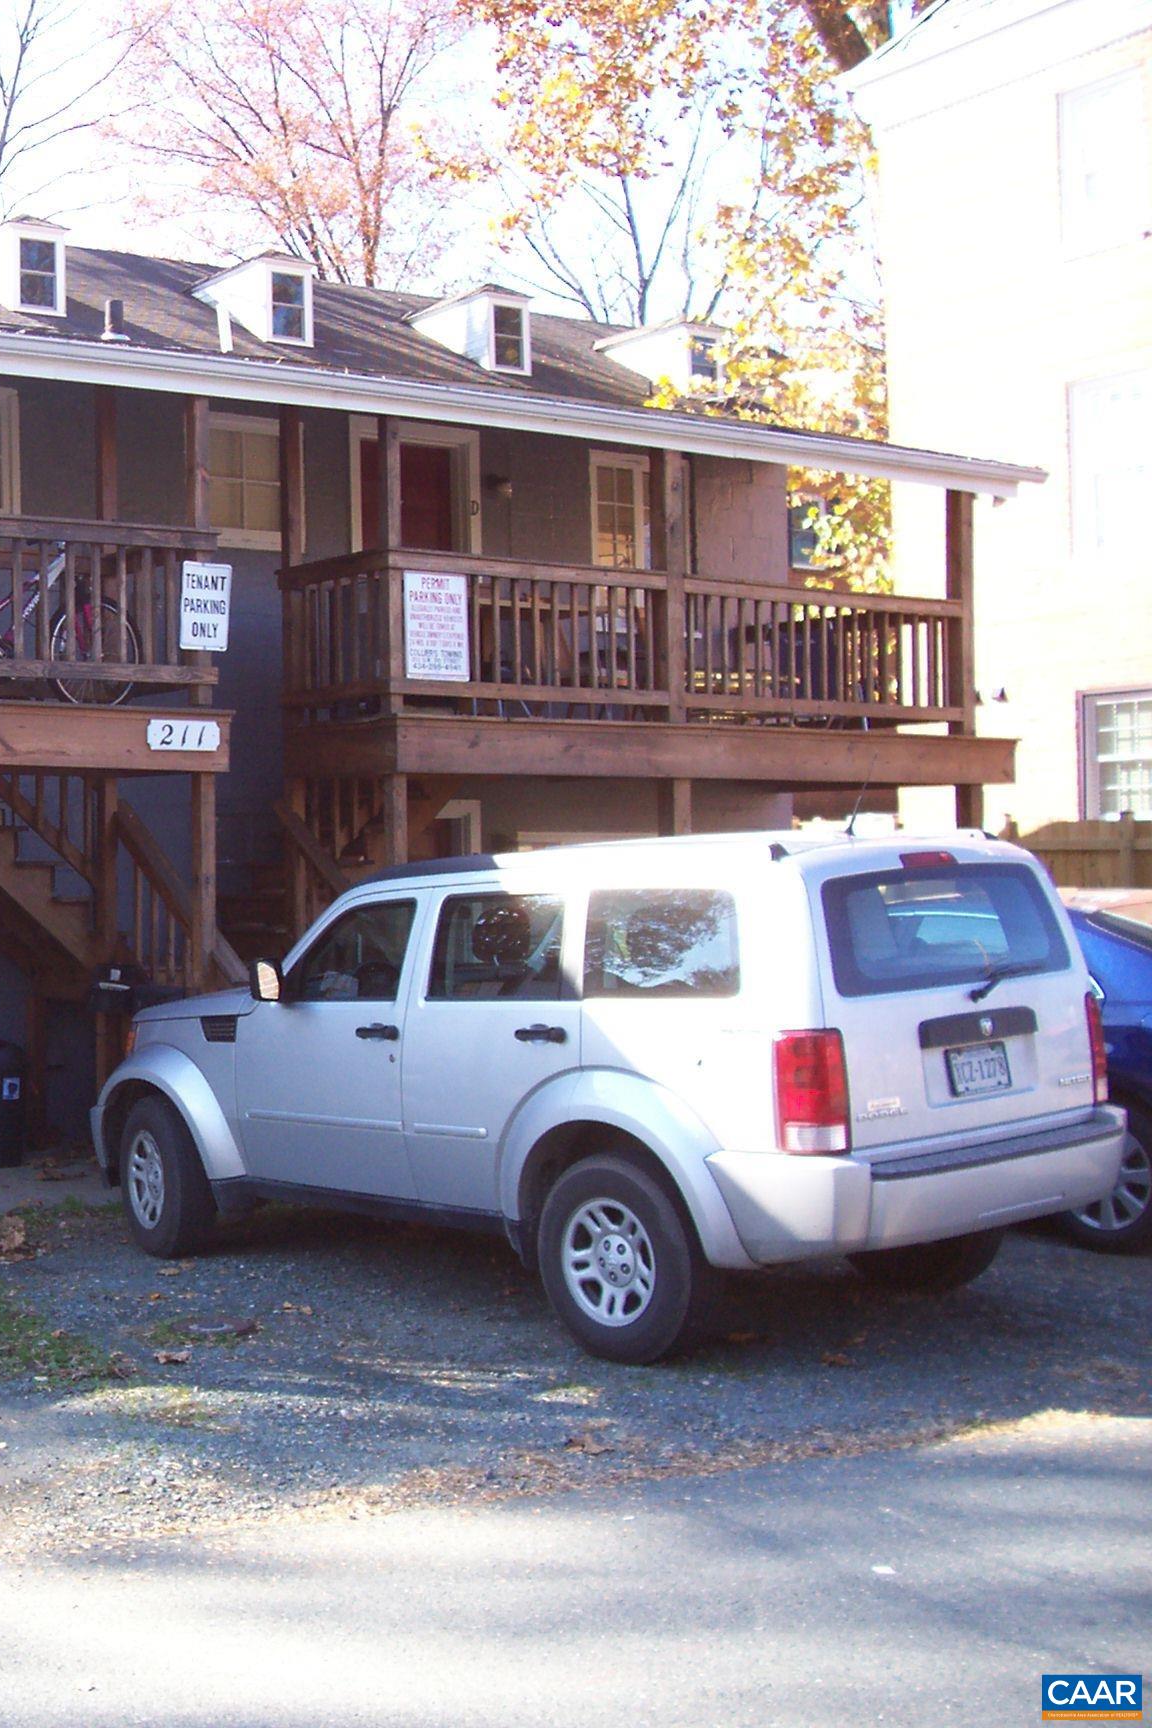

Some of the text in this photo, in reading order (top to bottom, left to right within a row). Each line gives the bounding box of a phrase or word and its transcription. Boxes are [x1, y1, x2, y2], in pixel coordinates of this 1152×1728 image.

[185, 573, 227, 592] TENANT
[421, 576, 450, 590] PERMIT
[183, 597, 227, 616] PARKING
[409, 590, 463, 606] PARKING ONLY
[191, 621, 219, 639] ONLY
[160, 724, 206, 747] 211
